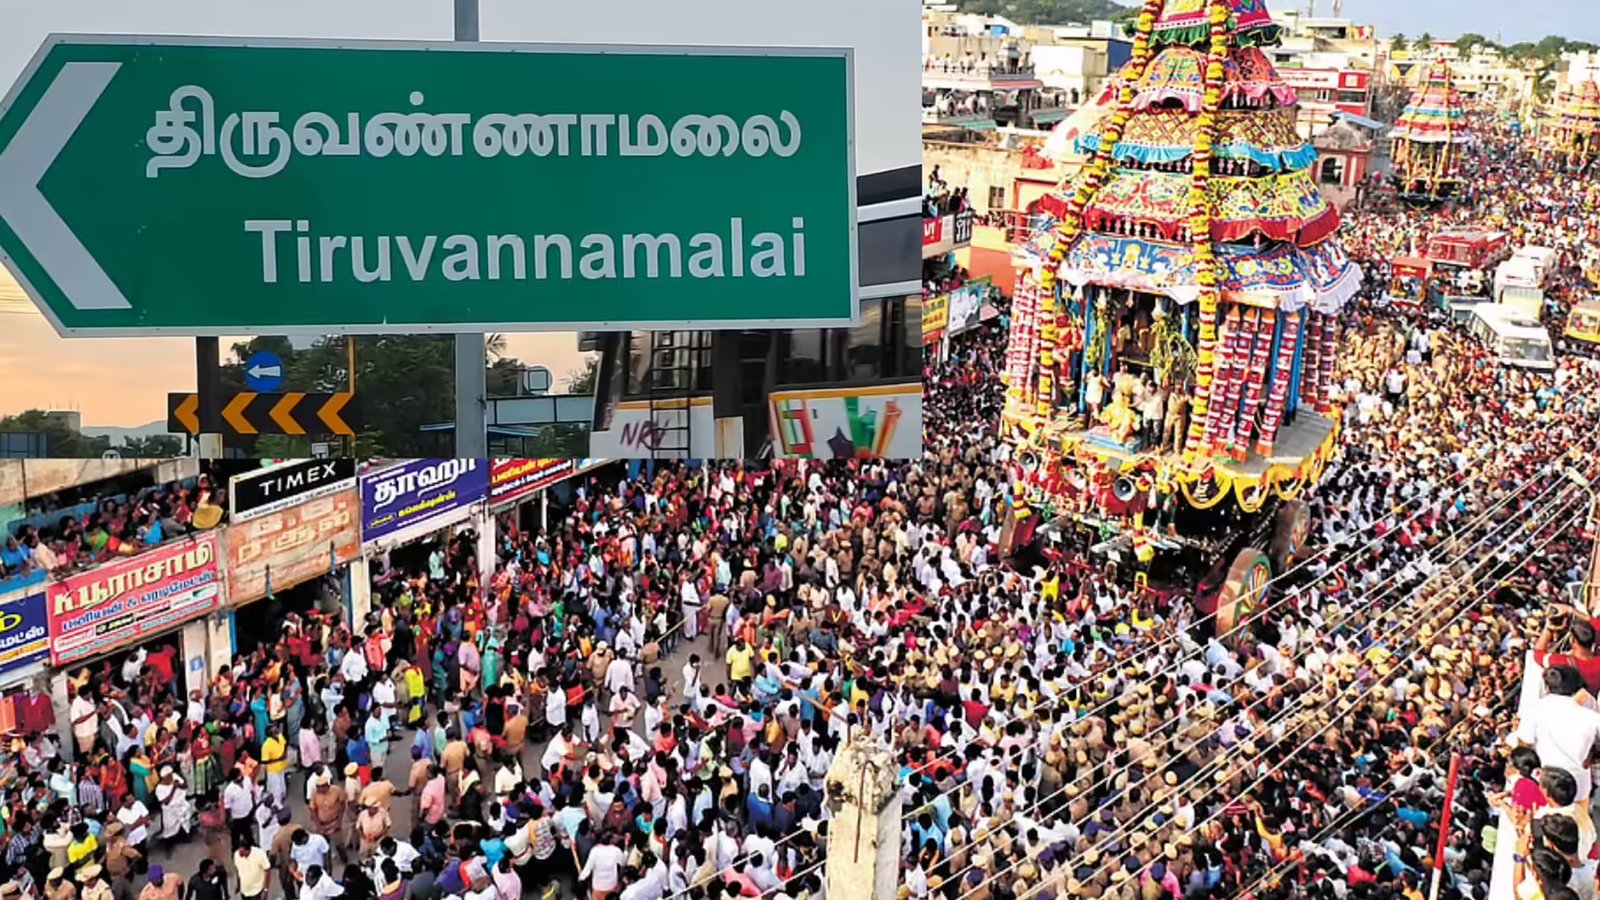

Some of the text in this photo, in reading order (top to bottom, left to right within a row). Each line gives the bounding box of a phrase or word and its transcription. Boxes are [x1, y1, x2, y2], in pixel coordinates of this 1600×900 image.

[146, 85, 801, 178] திருவண்ணாமலை
[245, 217, 805, 283] Tiruvannamalai
[260, 461, 336, 496] TIMEX
